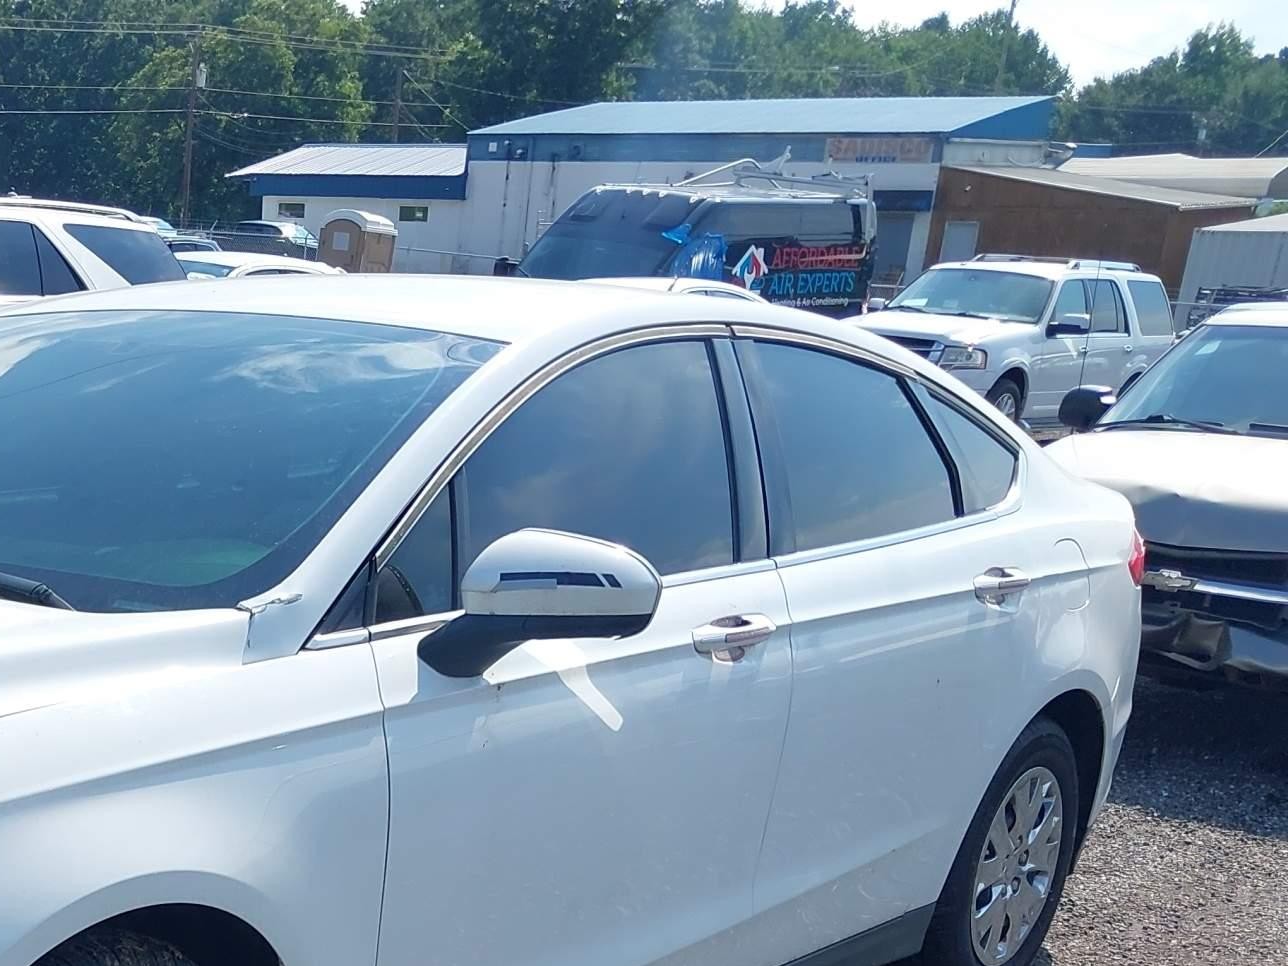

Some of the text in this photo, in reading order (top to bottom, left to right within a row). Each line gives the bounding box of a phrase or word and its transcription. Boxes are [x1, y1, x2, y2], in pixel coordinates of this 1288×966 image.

[773, 247, 860, 268] AFFORDABLE
[769, 272, 856, 295] AIR EXPERTS
